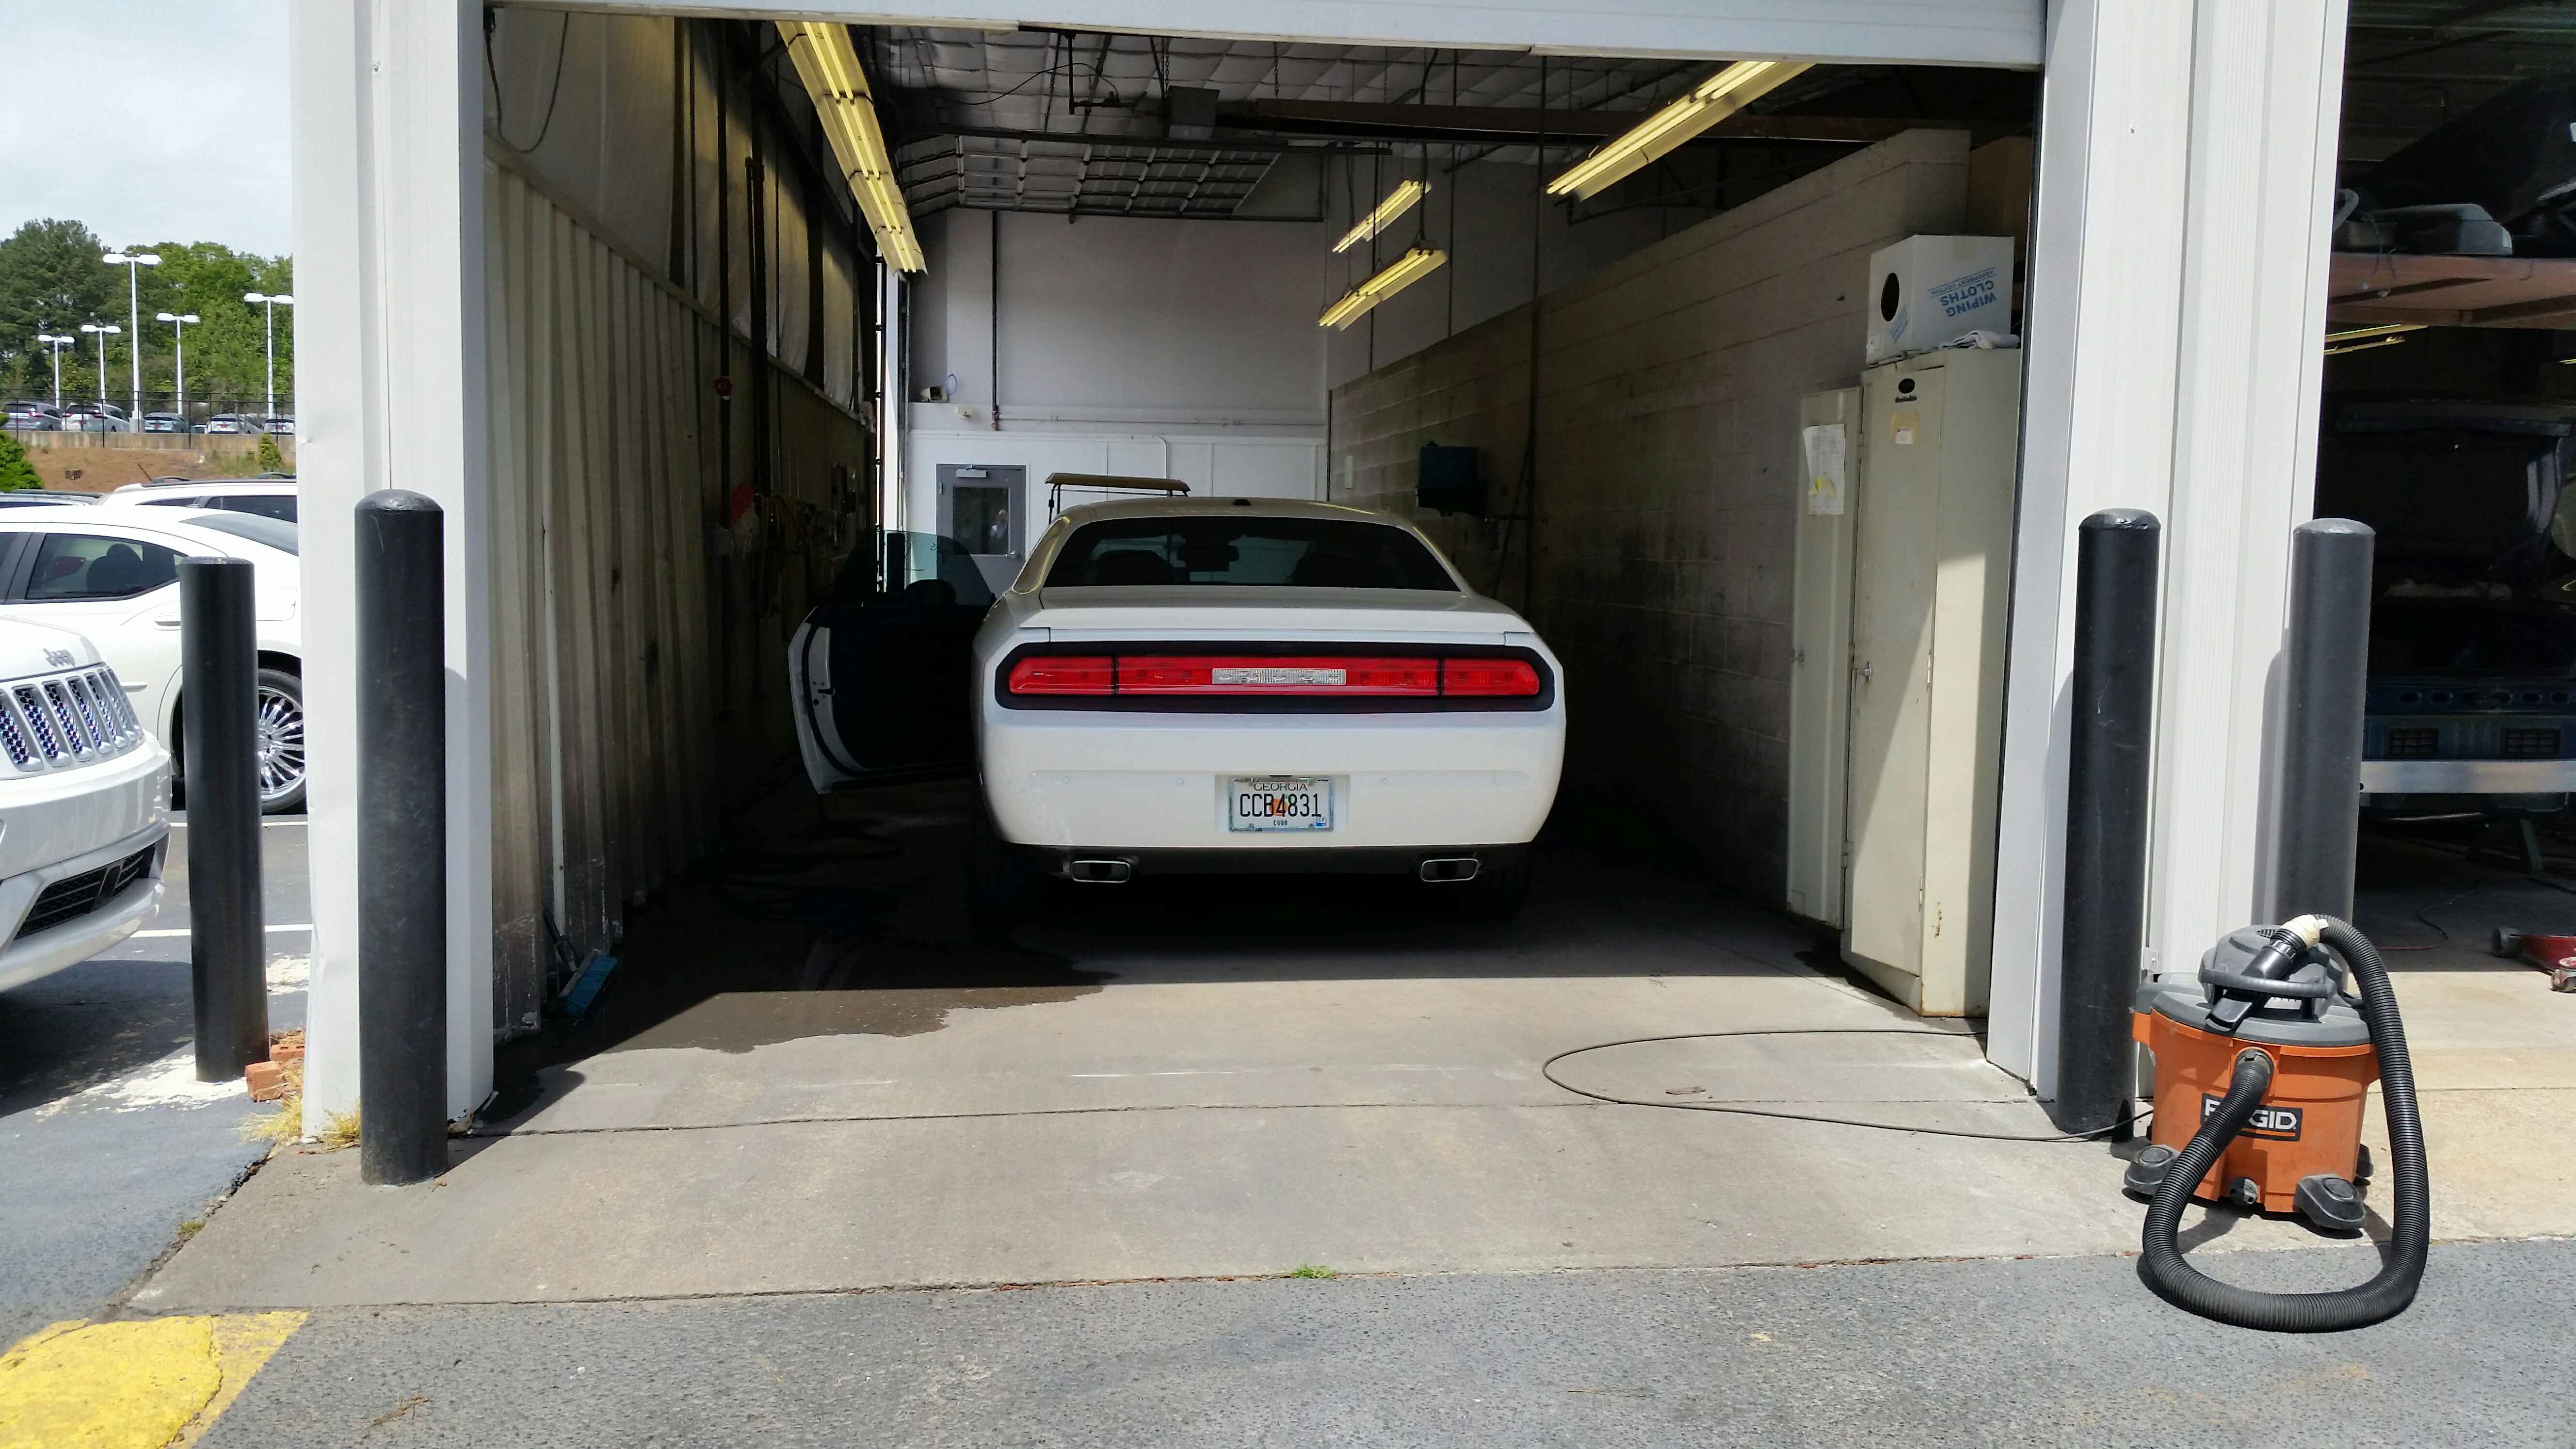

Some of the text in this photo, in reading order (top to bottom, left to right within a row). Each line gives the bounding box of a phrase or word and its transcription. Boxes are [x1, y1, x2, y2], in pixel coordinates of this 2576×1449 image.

[1941, 280, 1994, 306] CLOTHS
[1946, 293, 1997, 317] WIPING
[1240, 793, 1321, 817] CCB4831
[2205, 1098, 2297, 1129] RGID
